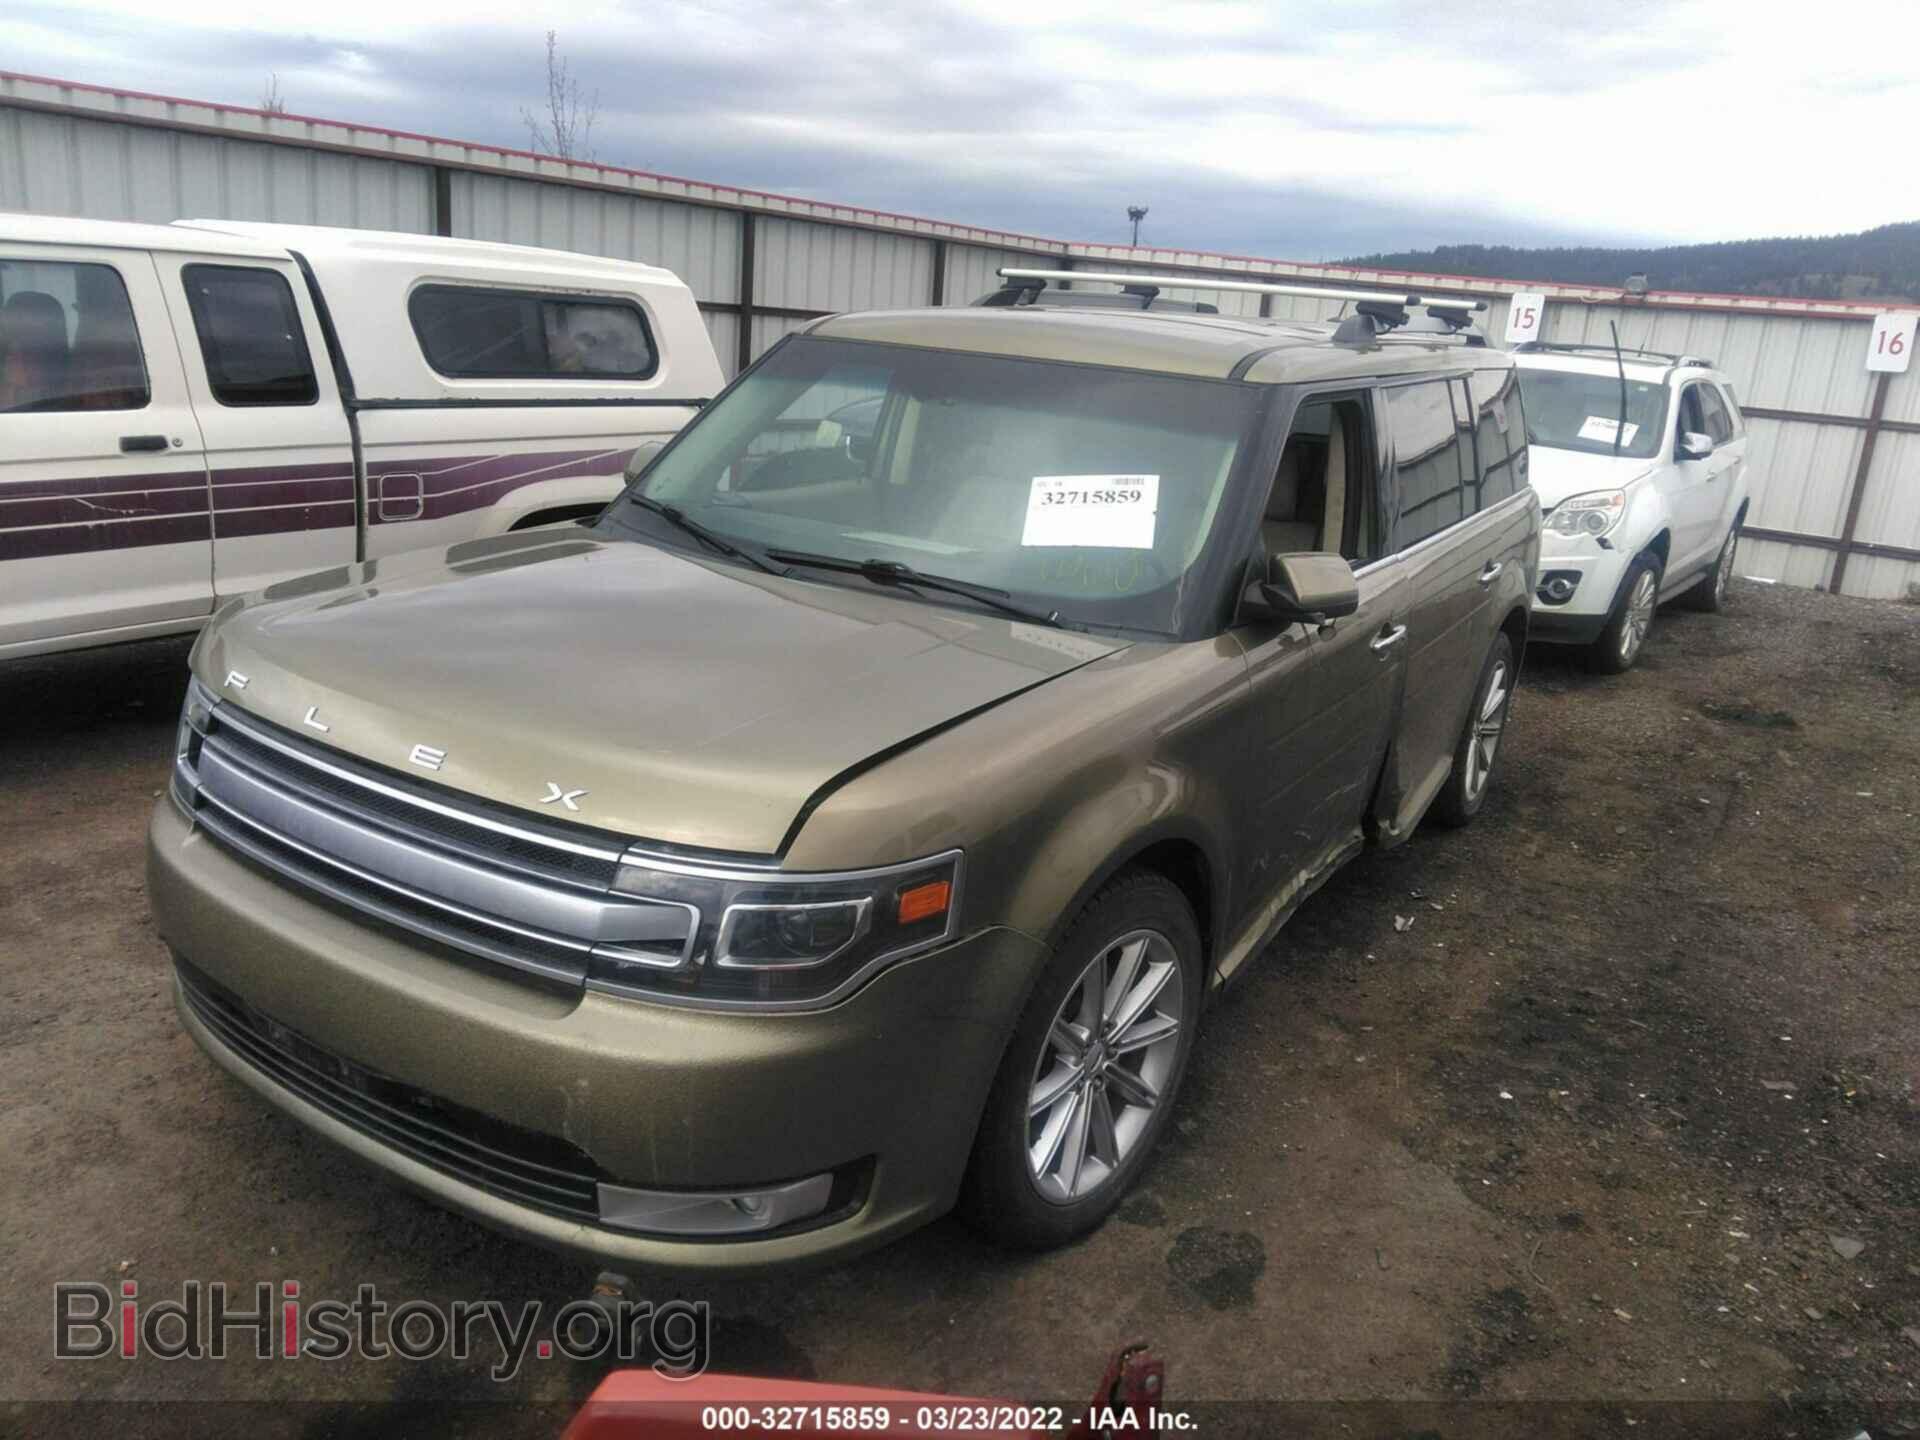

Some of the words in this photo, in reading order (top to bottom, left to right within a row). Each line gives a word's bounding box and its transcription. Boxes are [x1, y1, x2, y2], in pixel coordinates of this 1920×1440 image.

[1512, 306, 1536, 330] 15
[1876, 330, 1904, 355] 16
[1041, 489, 1142, 505] 32715859
[224, 670, 590, 811] FLEX
